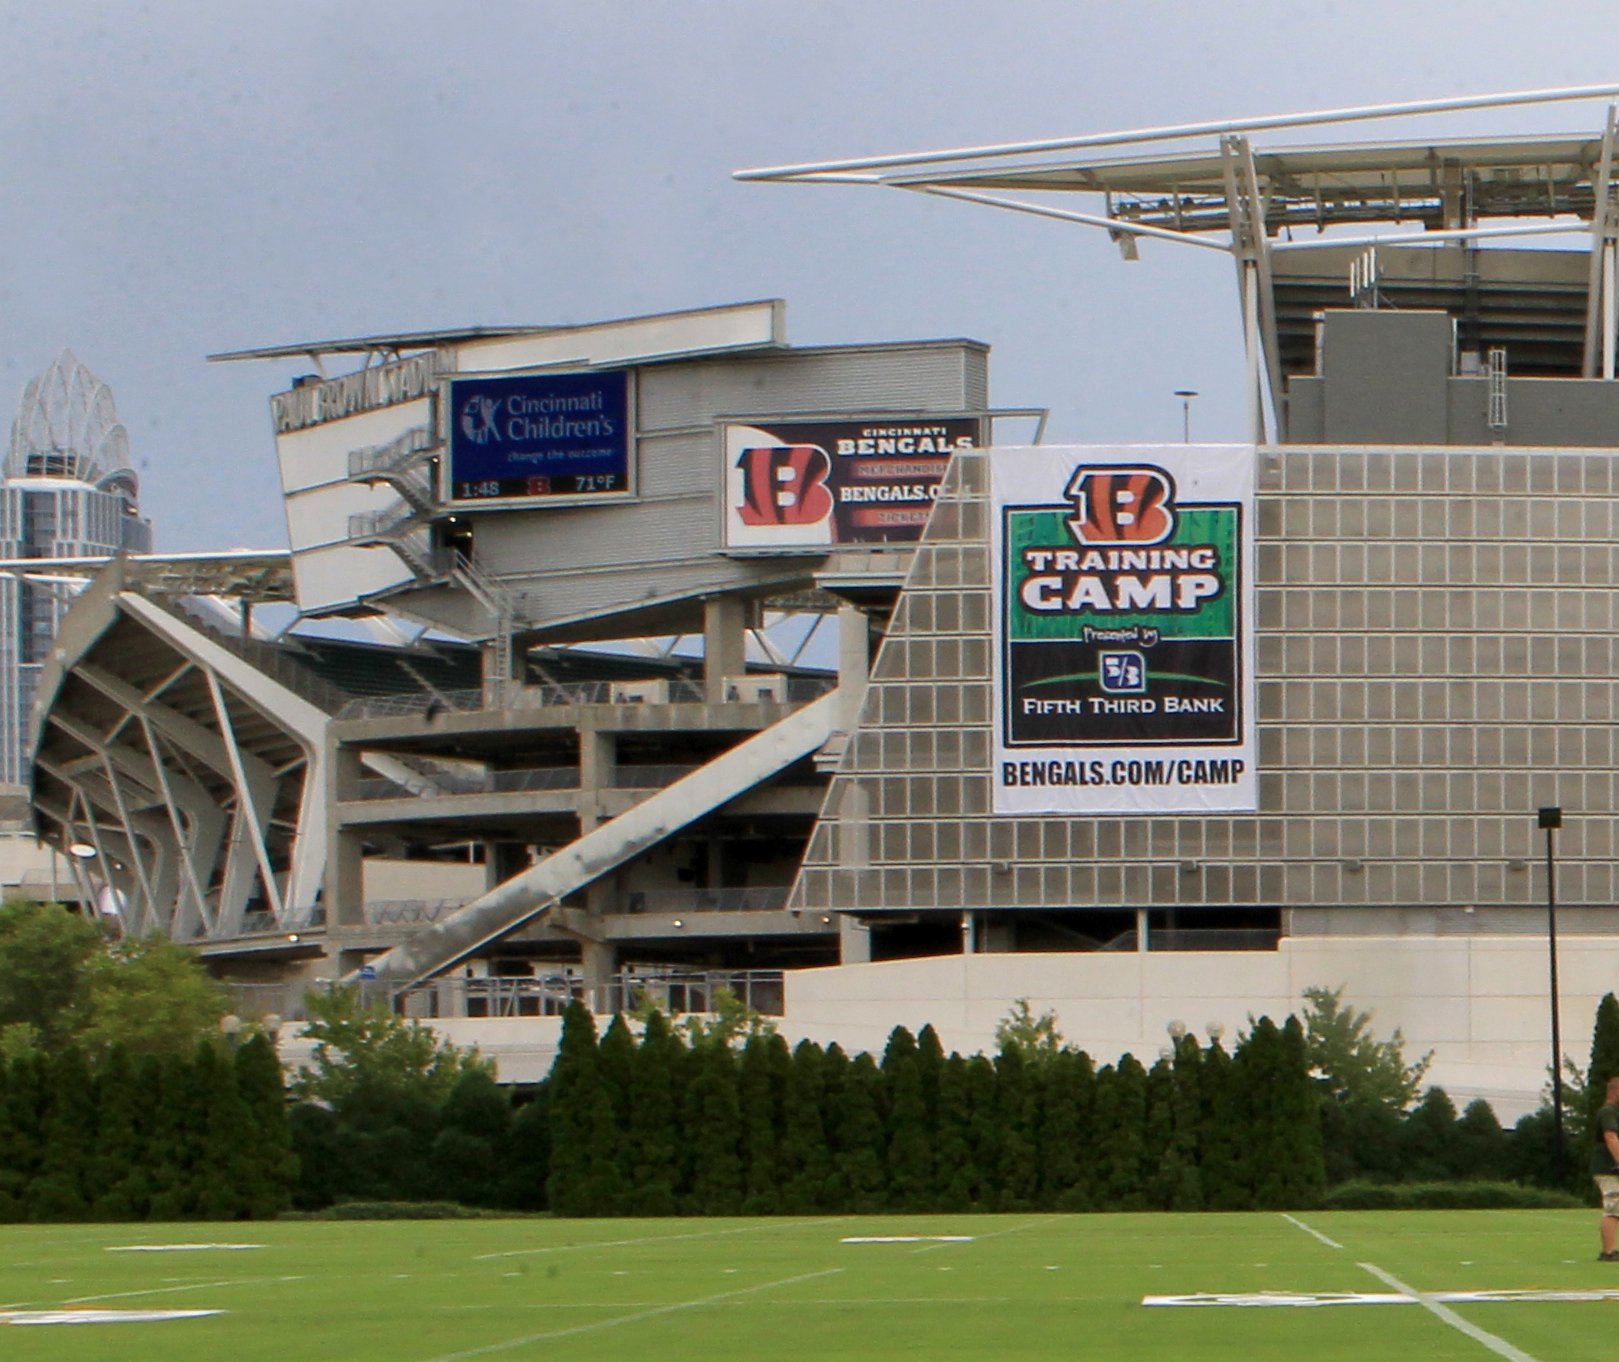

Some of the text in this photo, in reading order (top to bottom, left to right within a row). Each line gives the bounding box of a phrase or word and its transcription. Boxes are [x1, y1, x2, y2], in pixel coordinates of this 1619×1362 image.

[507, 391, 603, 415] Cincinnati
[507, 415, 614, 440] Children's
[862, 427, 947, 438] CINCINNATI
[508, 451, 544, 464] change
[547, 449, 565, 460] the
[837, 436, 974, 456] BENGALS
[462, 481, 500, 497] 1:48
[575, 475, 615, 491] 71°F
[736, 444, 833, 525] B
[1066, 466, 1176, 545] B
[1025, 549, 1217, 571] TRAINING
[1022, 574, 1220, 611] CAMP
[1083, 626, 1159, 648] Presented by
[1002, 759, 1245, 787] BENGALS.COM/CAMP
